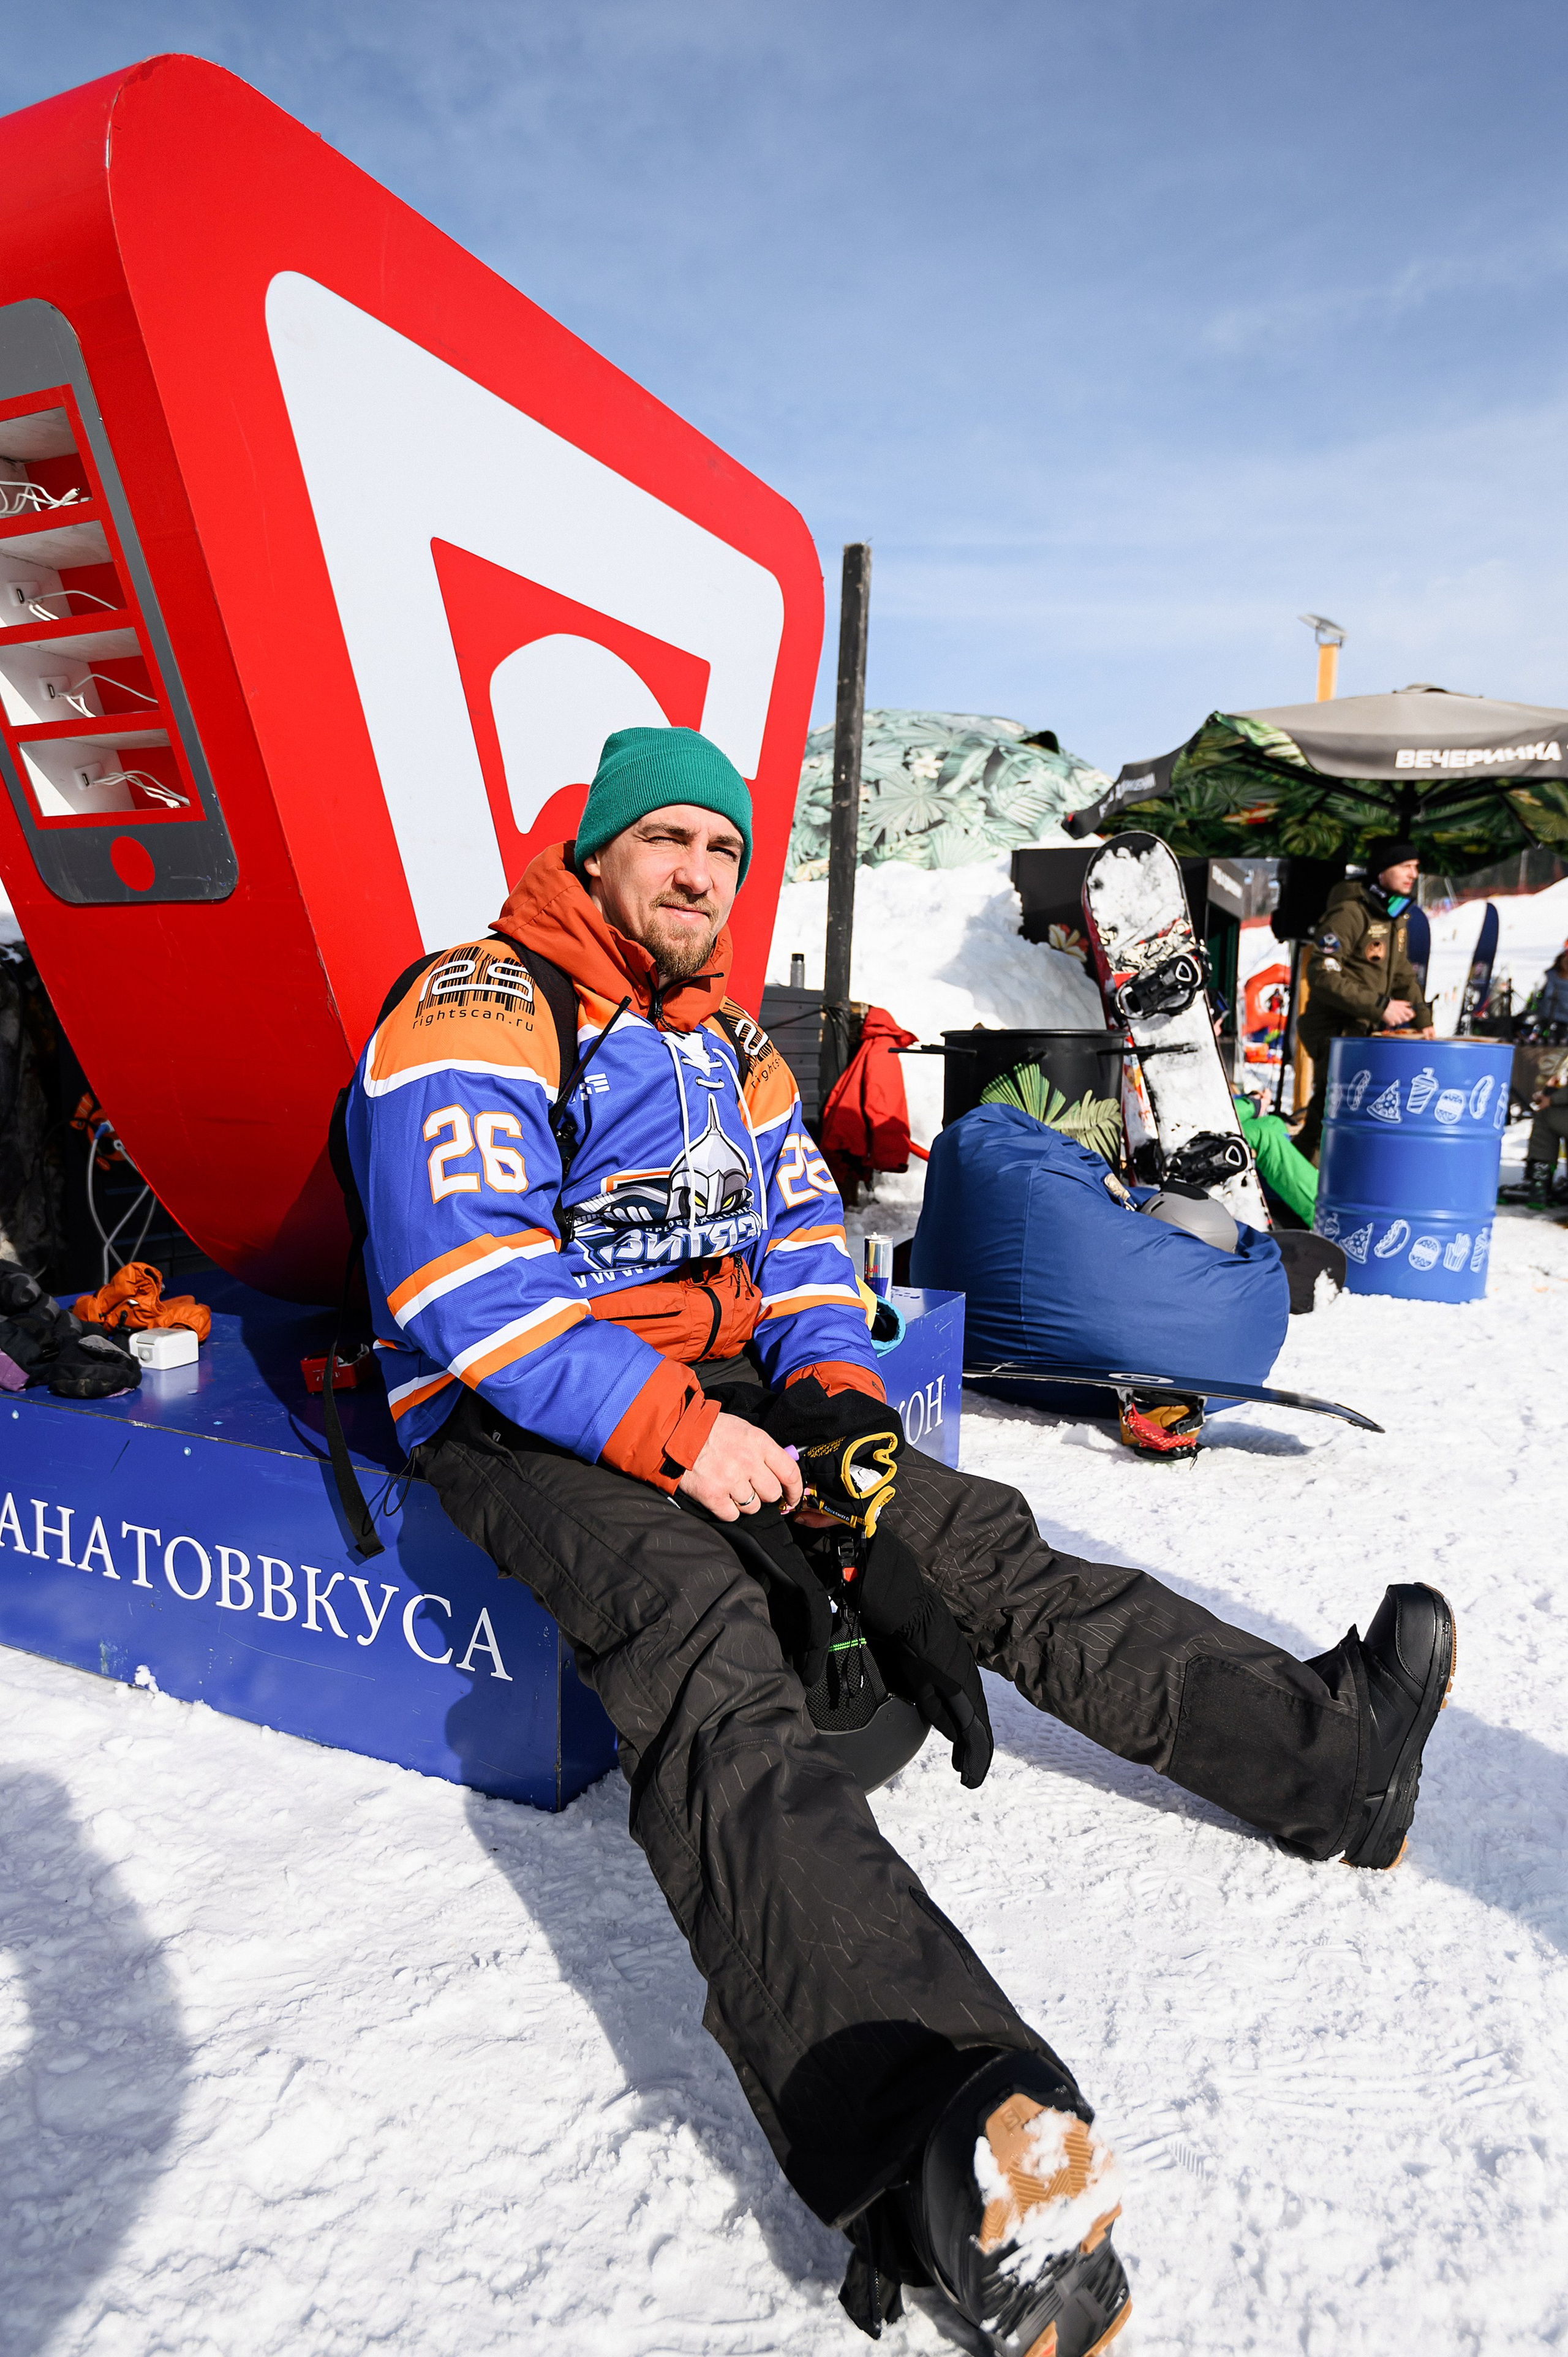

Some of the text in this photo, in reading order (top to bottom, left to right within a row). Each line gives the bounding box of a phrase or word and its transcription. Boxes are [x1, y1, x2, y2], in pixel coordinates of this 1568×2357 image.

[1395, 741, 1562, 769] ВЕЧЕРИНКА
[412, 1009, 533, 1031] rightscan.ru
[751, 1058, 780, 1089] rights
[423, 1104, 529, 1204] 26
[775, 1133, 840, 1210] 26
[0, 1492, 513, 1681] АНАТОВВКУСА
